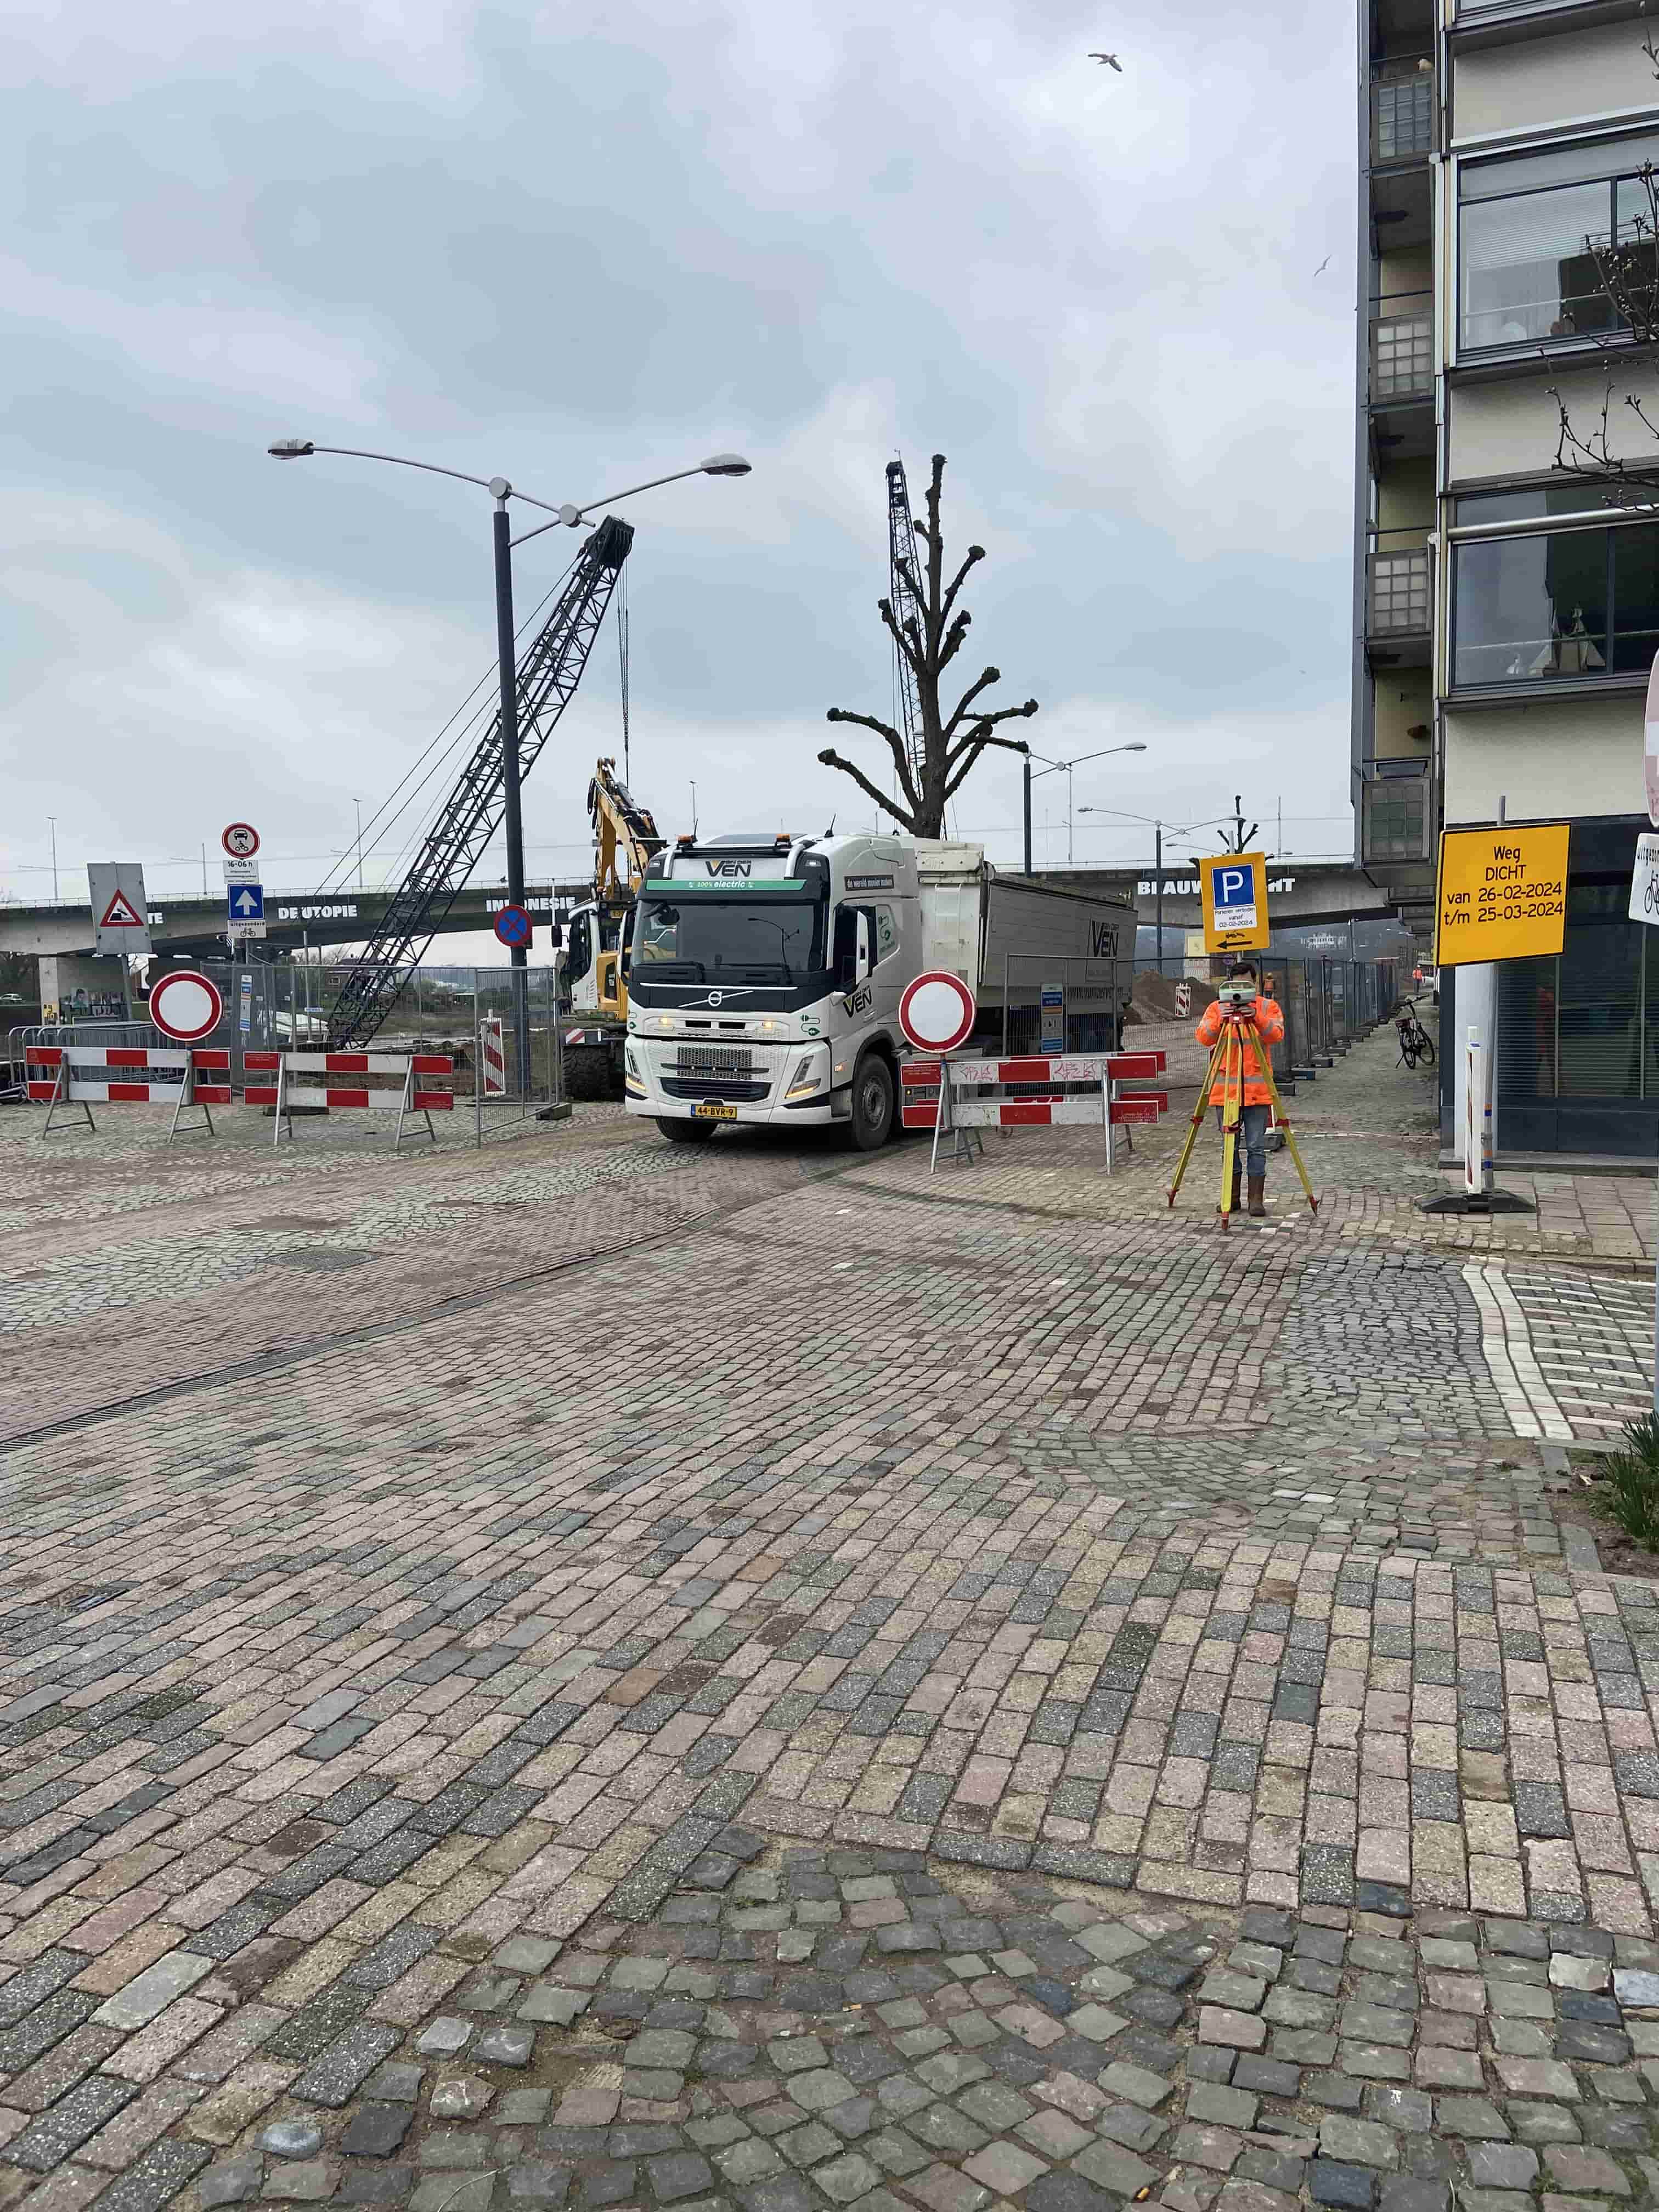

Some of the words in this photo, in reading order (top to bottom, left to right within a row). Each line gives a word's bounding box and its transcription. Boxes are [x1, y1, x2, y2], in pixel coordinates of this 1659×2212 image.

[1493, 845, 1521, 863] Weg
[705, 860, 751, 877] VEN
[1486, 865, 1526, 881] DICHT
[1222, 871, 1244, 903] P
[1447, 893, 1470, 904] van
[1479, 882, 1562, 902] 26-02-2024
[278, 907, 297, 919] DE
[302, 905, 358, 919] UTOPIE
[1444, 910, 1470, 926] t/m
[1478, 901, 1563, 922] 25-03-2024
[843, 986, 872, 1018] VEN
